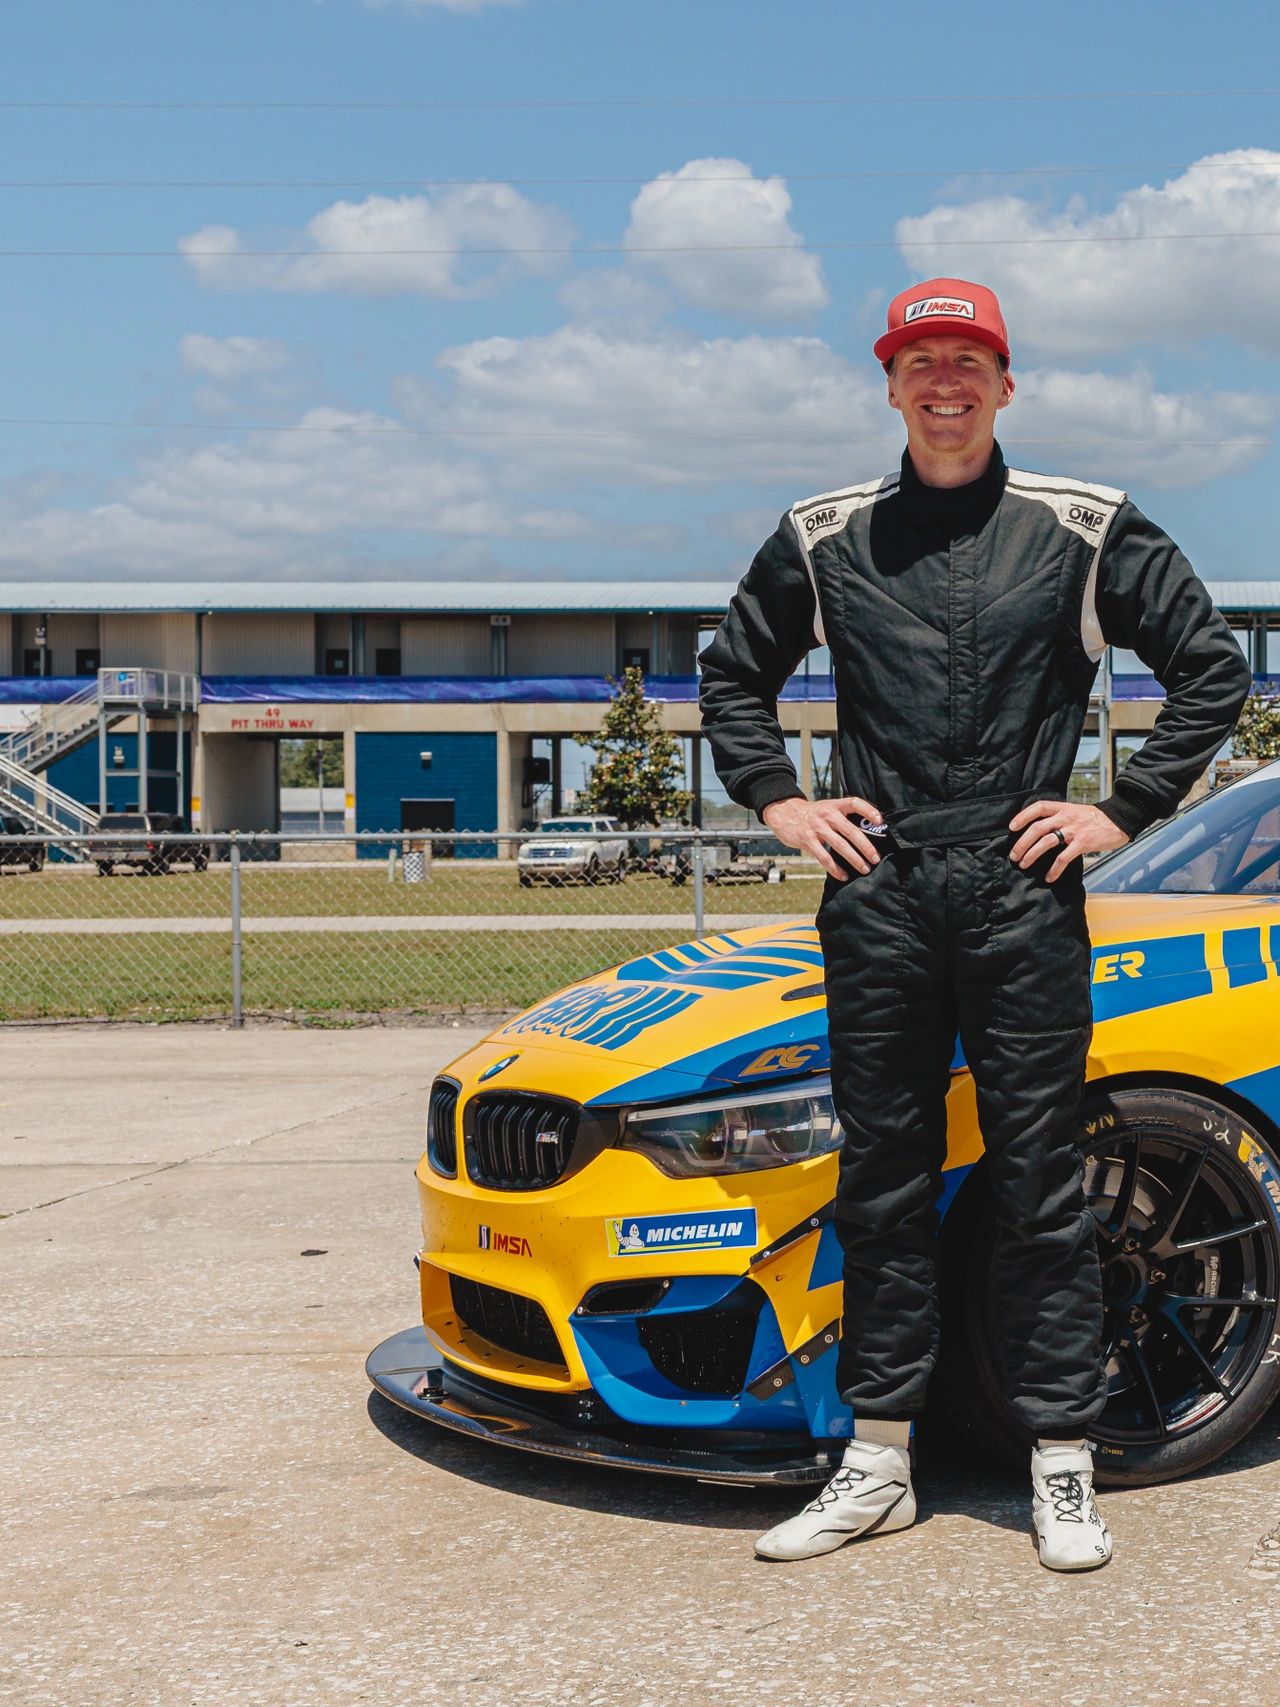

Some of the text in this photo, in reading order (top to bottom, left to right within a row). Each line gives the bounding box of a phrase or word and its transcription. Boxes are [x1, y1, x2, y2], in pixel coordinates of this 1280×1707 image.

[926, 302, 970, 315] IMSA
[805, 509, 837, 532] OMP
[1068, 507, 1104, 528] OMP
[265, 708, 280, 717] 49
[231, 720, 313, 729] PIT THRU WAY
[646, 1221, 743, 1243] MICHELIN
[493, 1232, 533, 1258] IMSA
